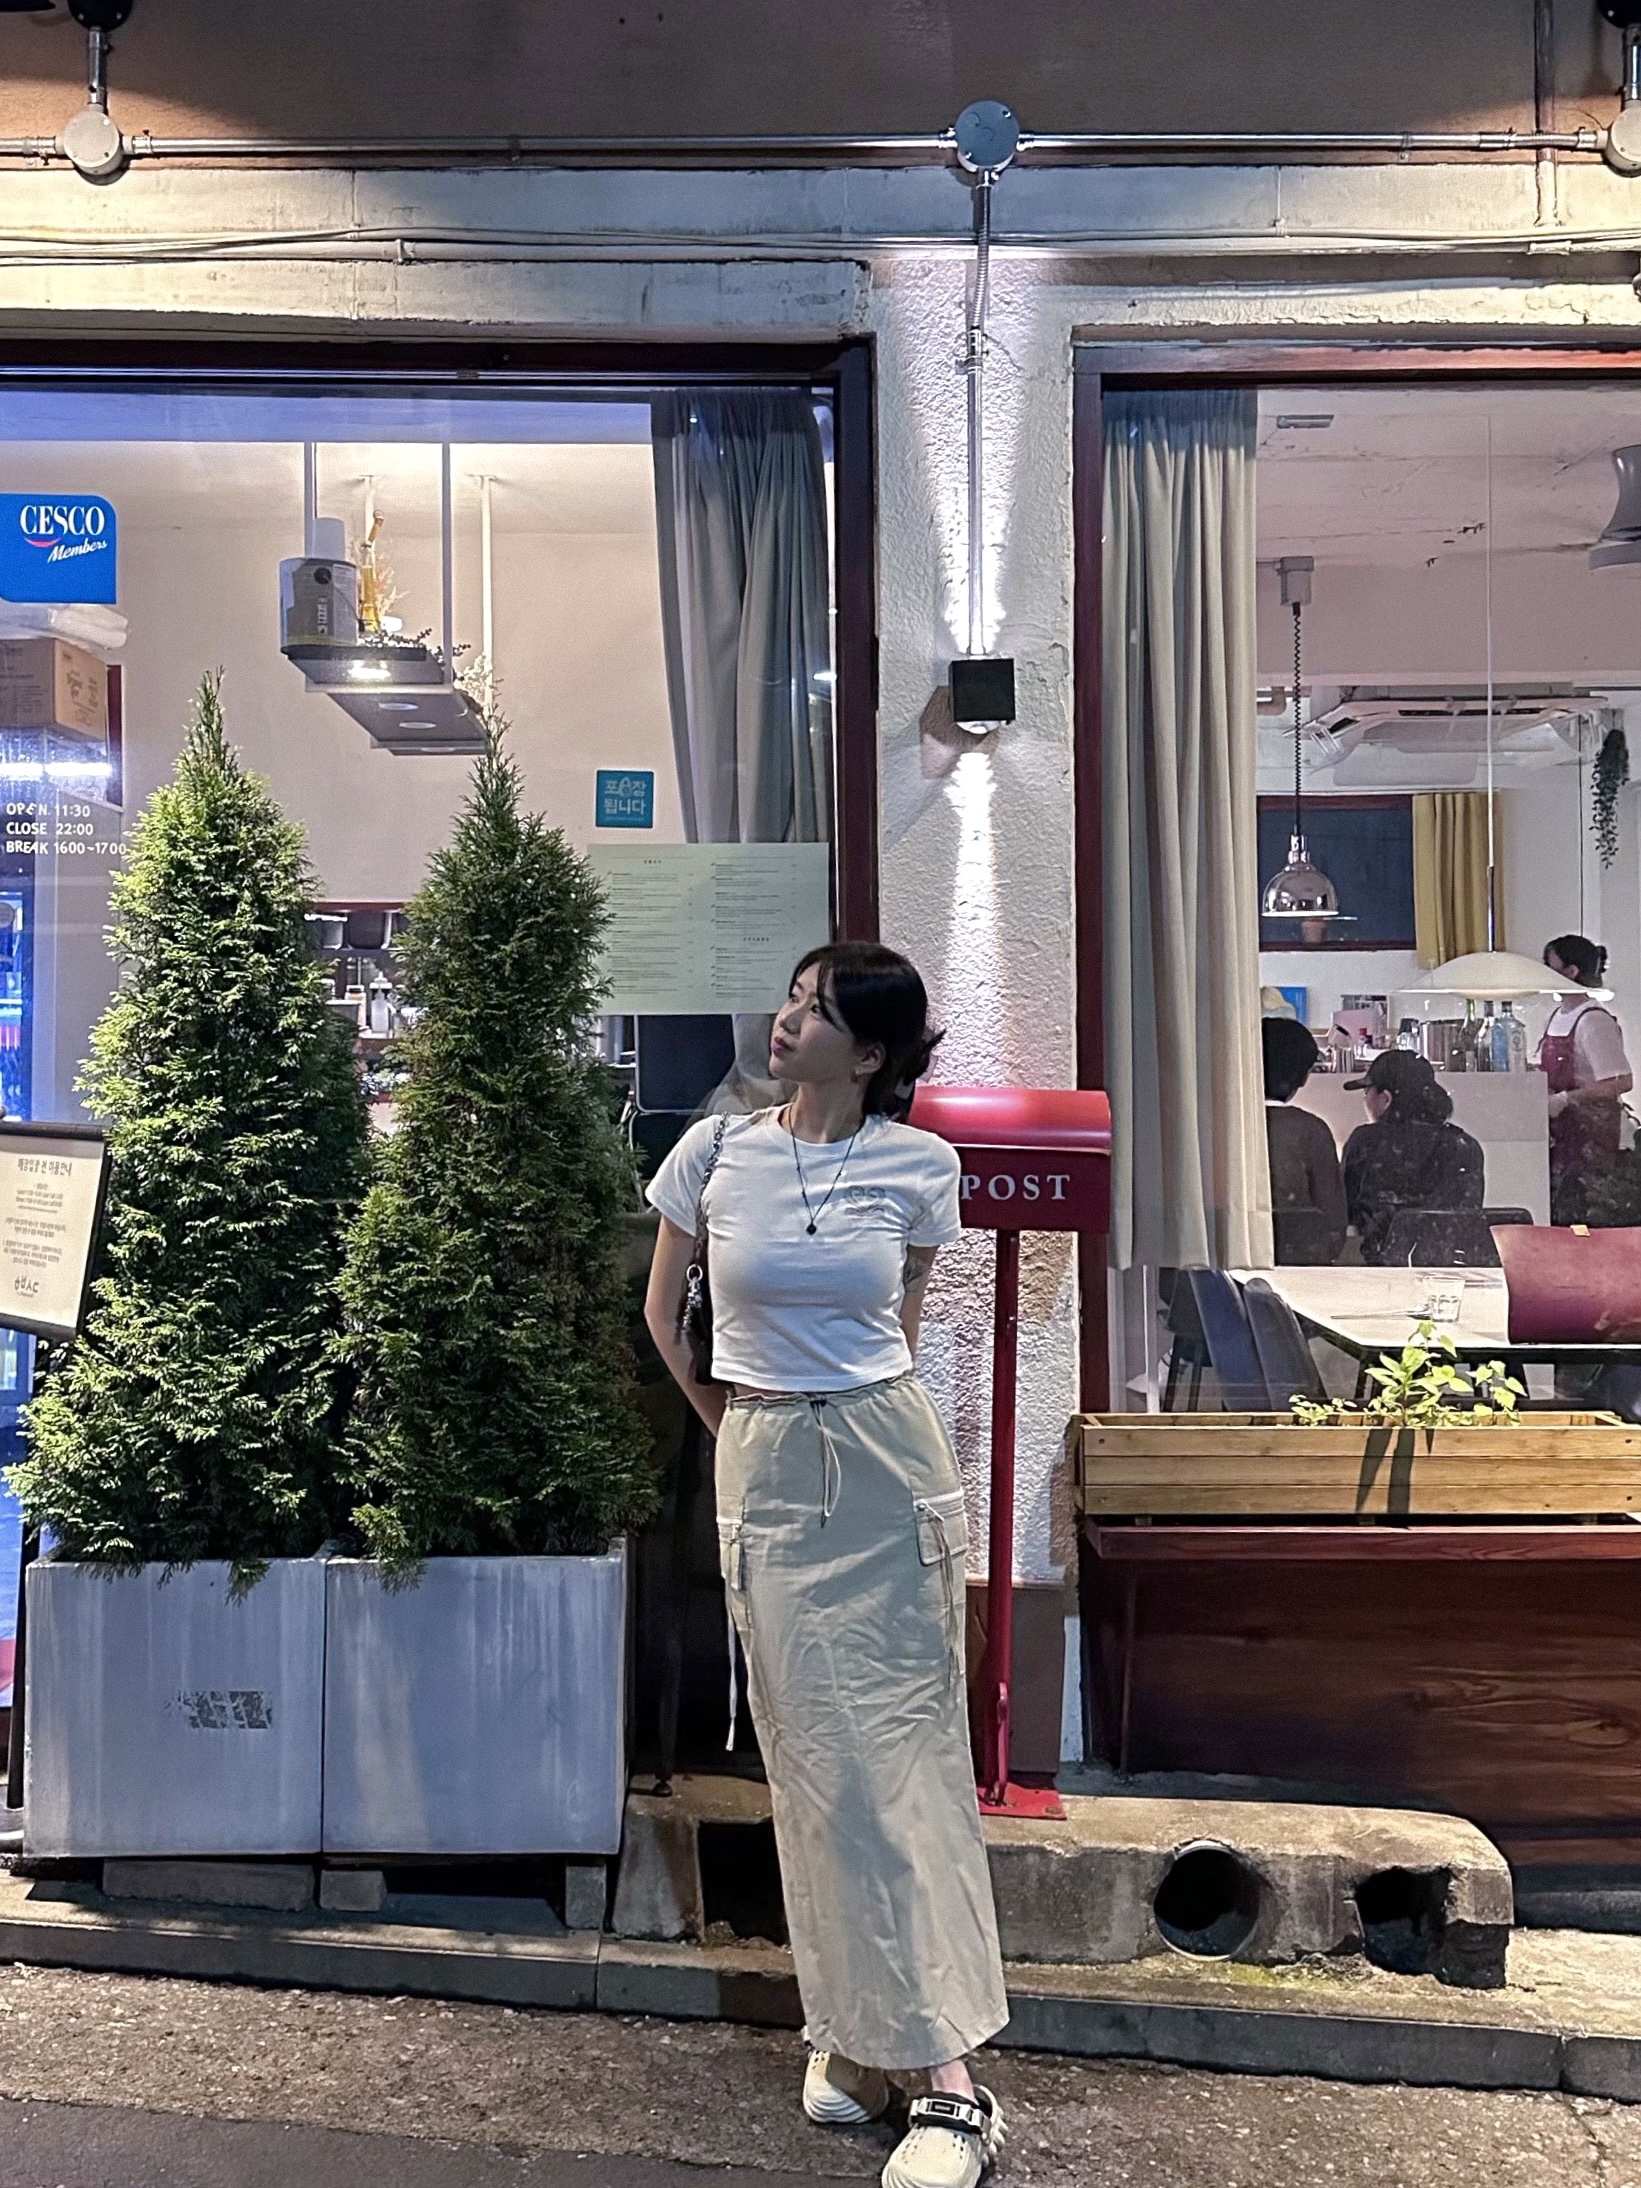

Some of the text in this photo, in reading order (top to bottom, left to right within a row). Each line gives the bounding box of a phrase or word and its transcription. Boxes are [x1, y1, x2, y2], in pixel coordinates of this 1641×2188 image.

[20, 505, 105, 535] CESCO
[47, 537, 107, 563] Members
[604, 777, 646, 797] 포장
[54, 804, 90, 817] 11:30
[604, 798, 646, 815] 됩니다
[6, 821, 94, 836] CLOSE 22:00
[6, 840, 127, 854] BREAK 1600~1700
[960, 1174, 1070, 1201] POST
